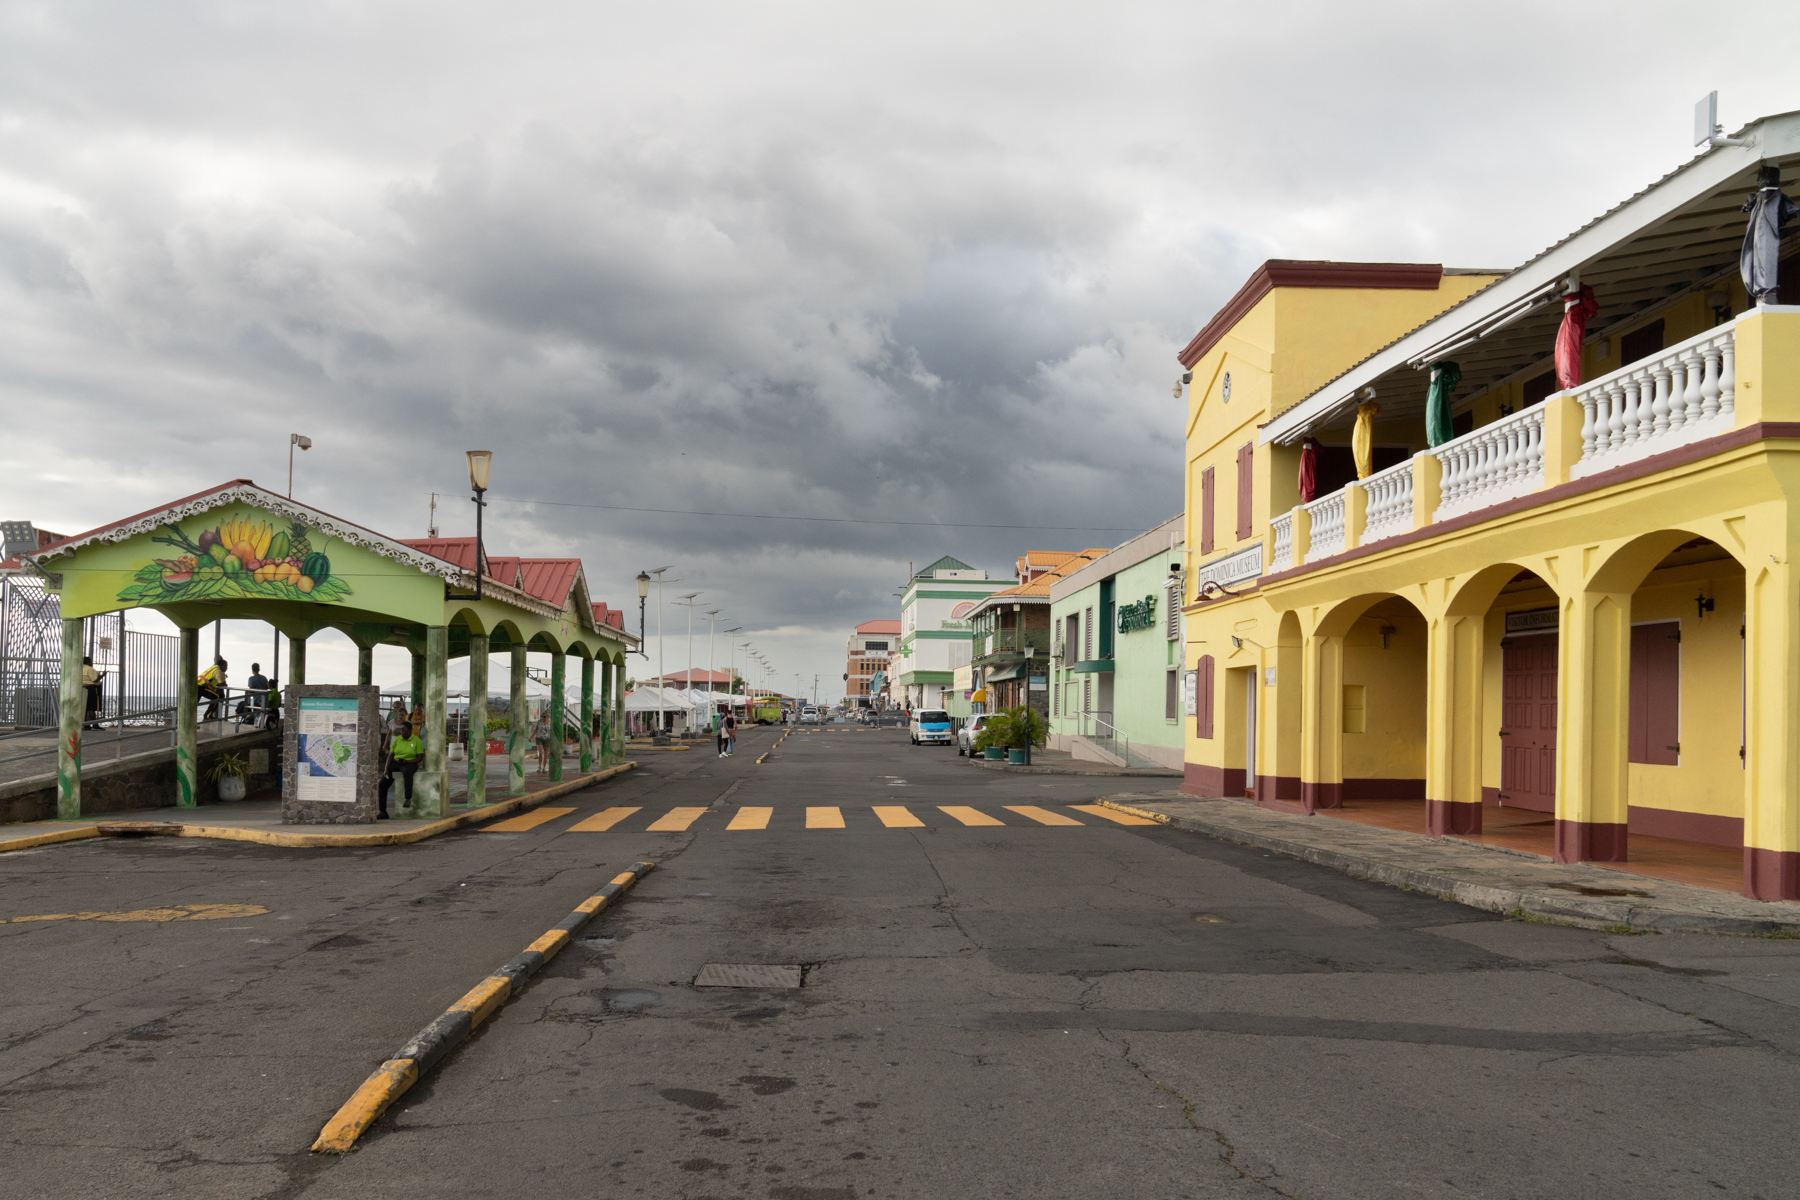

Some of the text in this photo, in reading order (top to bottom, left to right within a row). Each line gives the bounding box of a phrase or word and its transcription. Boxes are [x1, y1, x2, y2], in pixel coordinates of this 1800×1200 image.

[1236, 552, 1260, 576] MUSEUM
[941, 620, 962, 628] Fresh
[1508, 611, 1559, 627] VISITOR INFORMAT
